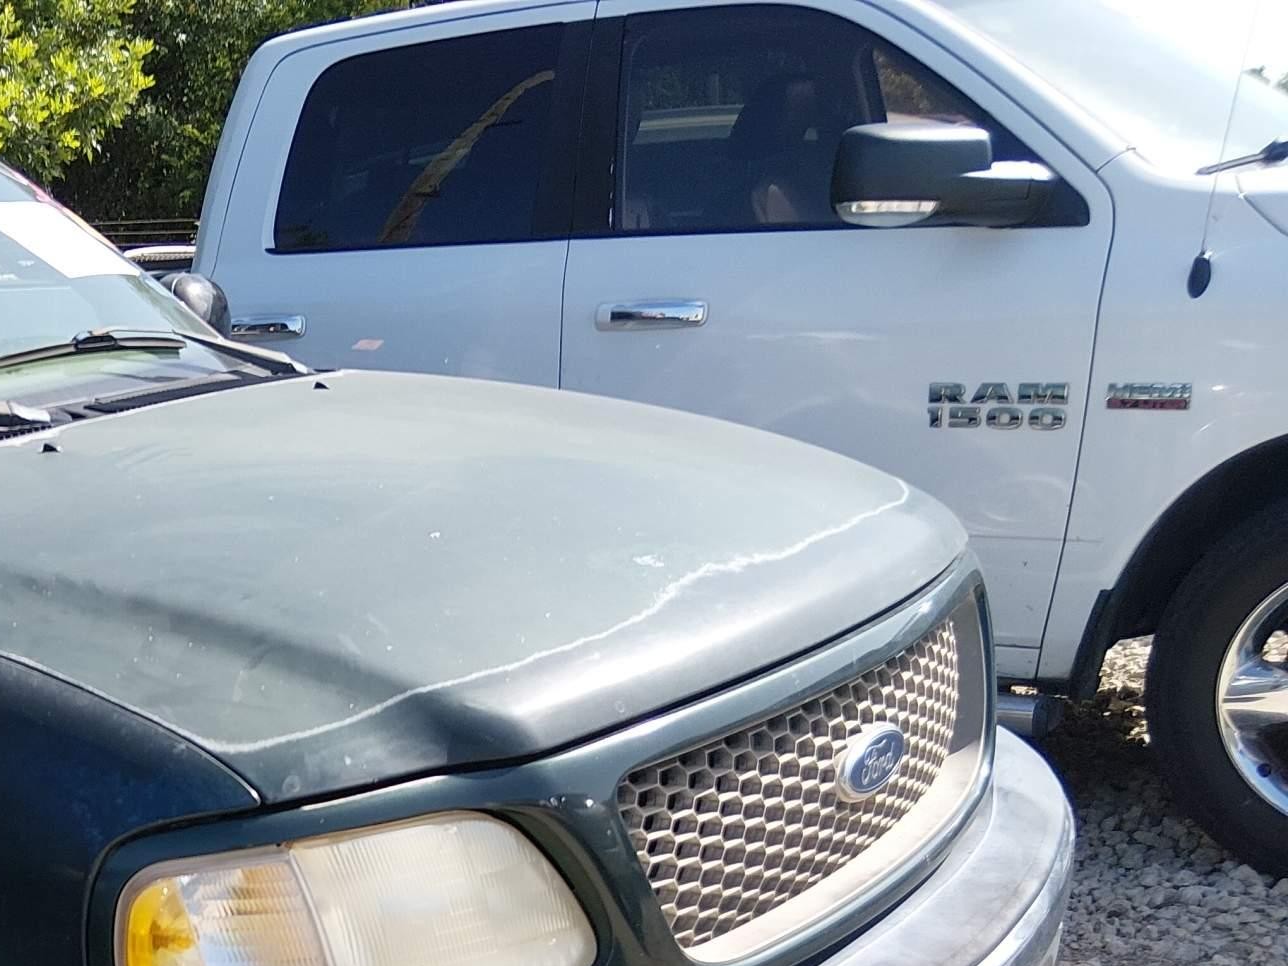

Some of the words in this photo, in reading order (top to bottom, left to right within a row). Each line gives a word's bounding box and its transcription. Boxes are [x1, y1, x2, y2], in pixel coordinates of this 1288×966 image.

[927, 382, 1070, 404] RAM
[927, 406, 1068, 431] 1500
[861, 738, 896, 786] Ford
